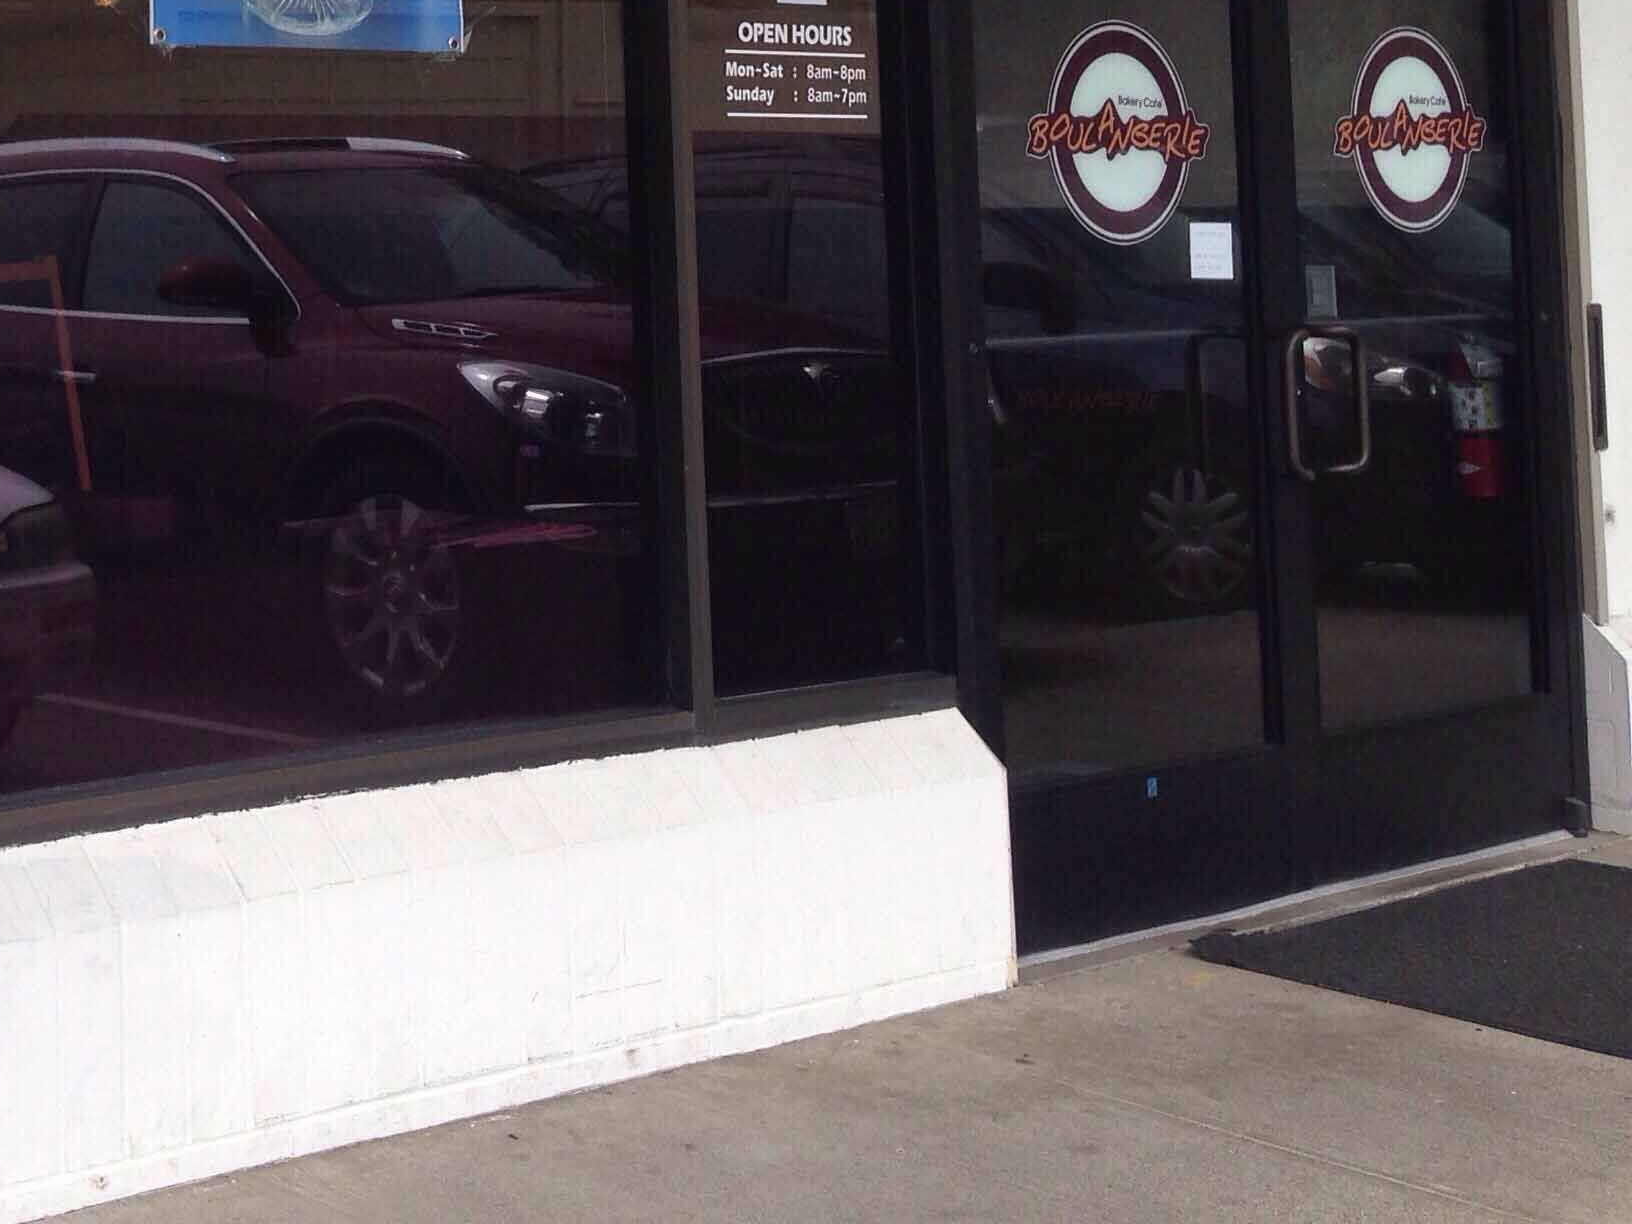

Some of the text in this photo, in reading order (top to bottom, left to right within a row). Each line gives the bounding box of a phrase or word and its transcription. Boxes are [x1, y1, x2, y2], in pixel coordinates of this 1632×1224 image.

[738, 22, 852, 47] OPEN HOURS
[726, 85, 774, 106] Sunday
[1031, 102, 1205, 162] BOULANGERIE
[1338, 101, 1482, 154] BOULANGERIE
